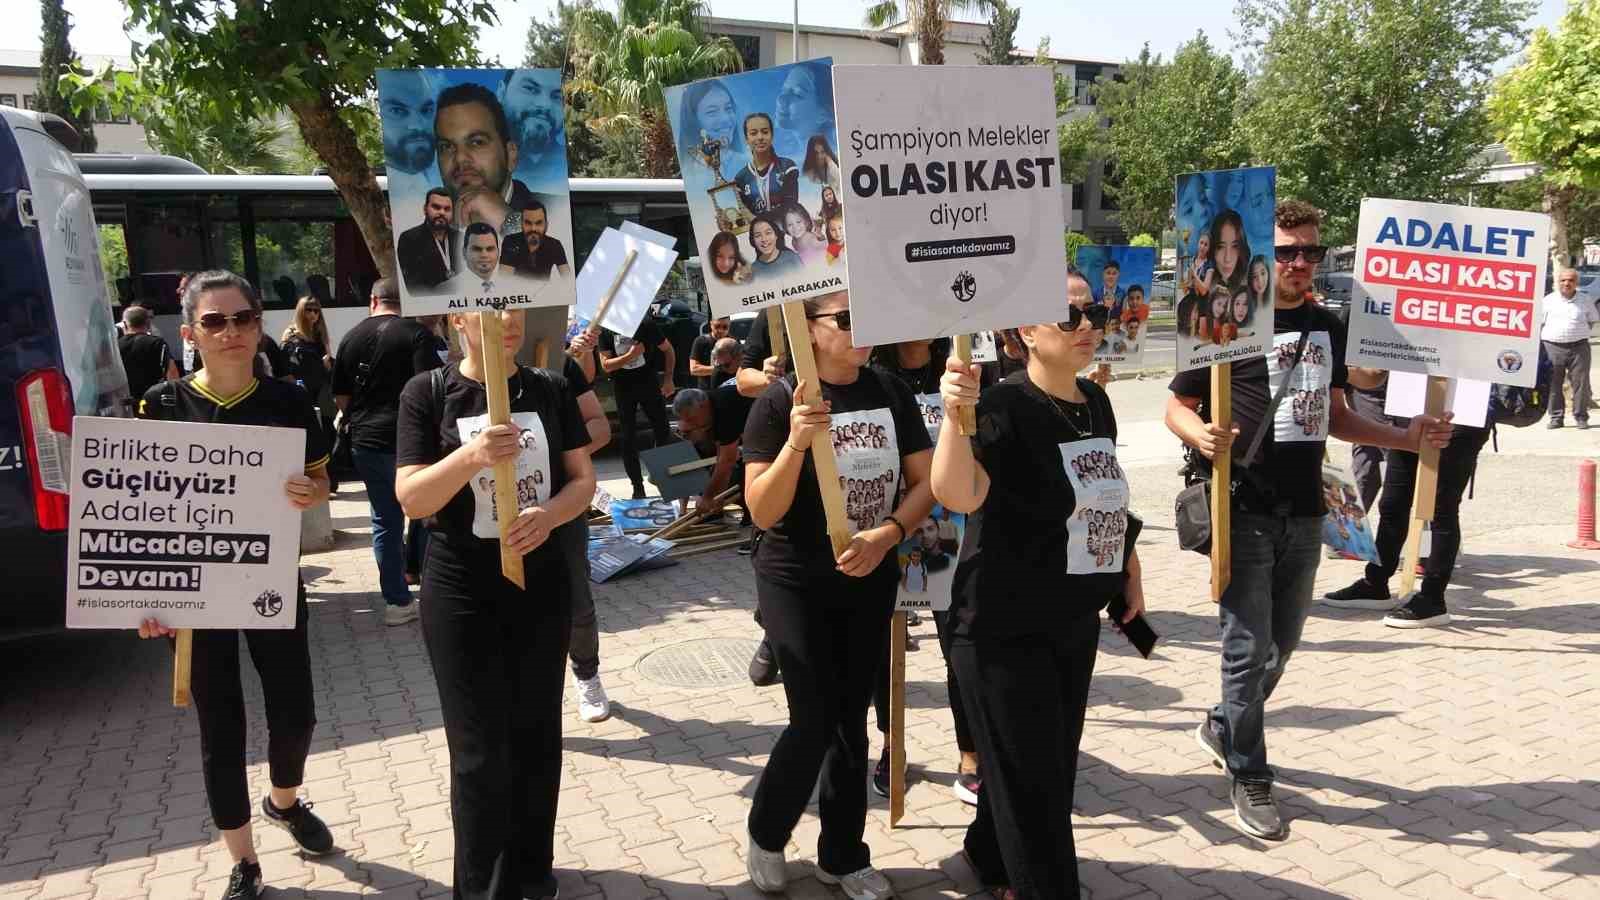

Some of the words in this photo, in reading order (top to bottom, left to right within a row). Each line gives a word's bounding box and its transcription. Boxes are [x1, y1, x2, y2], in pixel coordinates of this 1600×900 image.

[850, 127, 961, 158] Şampiyon
[968, 125, 1051, 148] Melekler
[851, 161, 958, 198] OLASI
[964, 157, 1055, 192] KAST
[929, 202, 988, 230] diyor!
[1375, 216, 1535, 258] ADALET
[1367, 256, 1450, 285] OLASI
[1457, 264, 1533, 292] KAST
[448, 296, 468, 308] ALİ
[741, 291, 775, 306] SELİN
[781, 277, 842, 297] KARAKAYA
[1363, 297, 1392, 316] İLE
[1401, 298, 1529, 332] GELECEK
[83, 438, 179, 463] Birlikte
[188, 444, 264, 467] Daha
[82, 467, 236, 499] Güçlüyüz!
[80, 500, 177, 523] Adalet
[186, 500, 234, 530] İçin
[79, 531, 267, 562] Mücadeleye
[78, 566, 201, 588] Devam!
